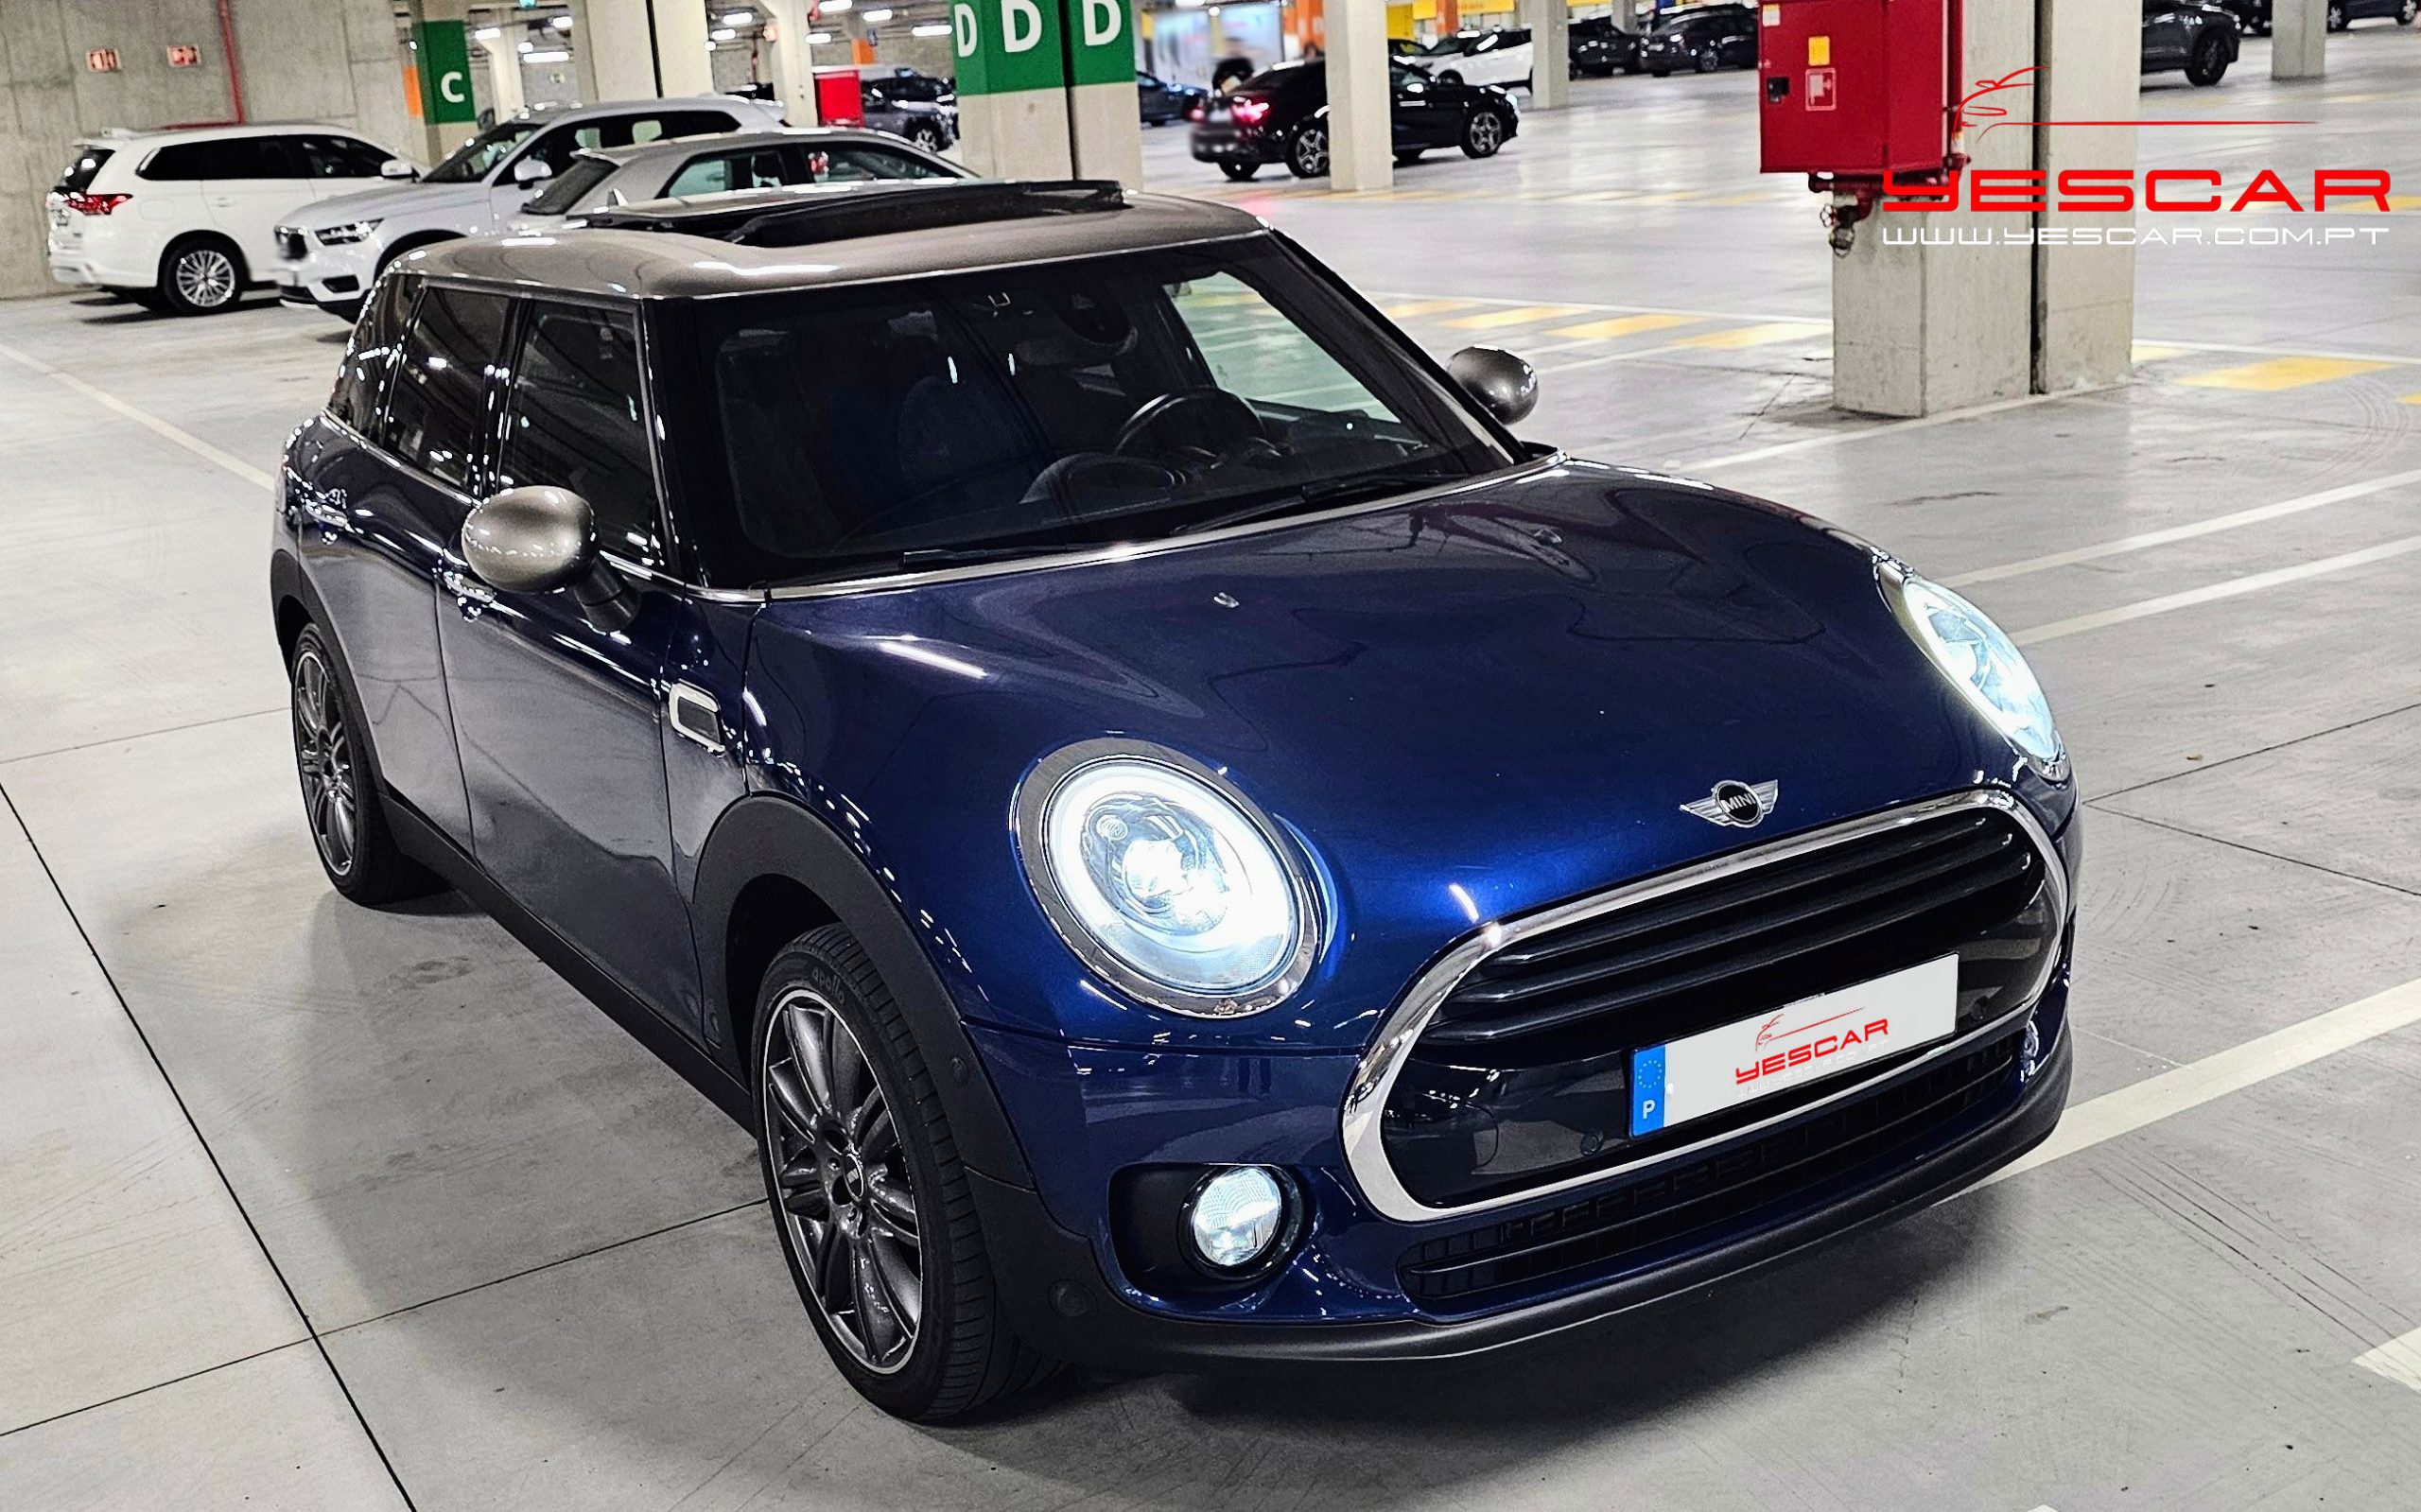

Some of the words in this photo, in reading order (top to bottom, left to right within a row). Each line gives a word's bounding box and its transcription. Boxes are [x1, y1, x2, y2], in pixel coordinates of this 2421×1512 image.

[953, 3, 978, 58] D
[1001, 0, 1042, 53] D
[1082, 0, 1123, 46] D
[441, 71, 465, 103] C
[1719, 792, 1756, 814] MINI
[811, 966, 845, 1004] apollo
[1643, 1099, 1656, 1120] P
